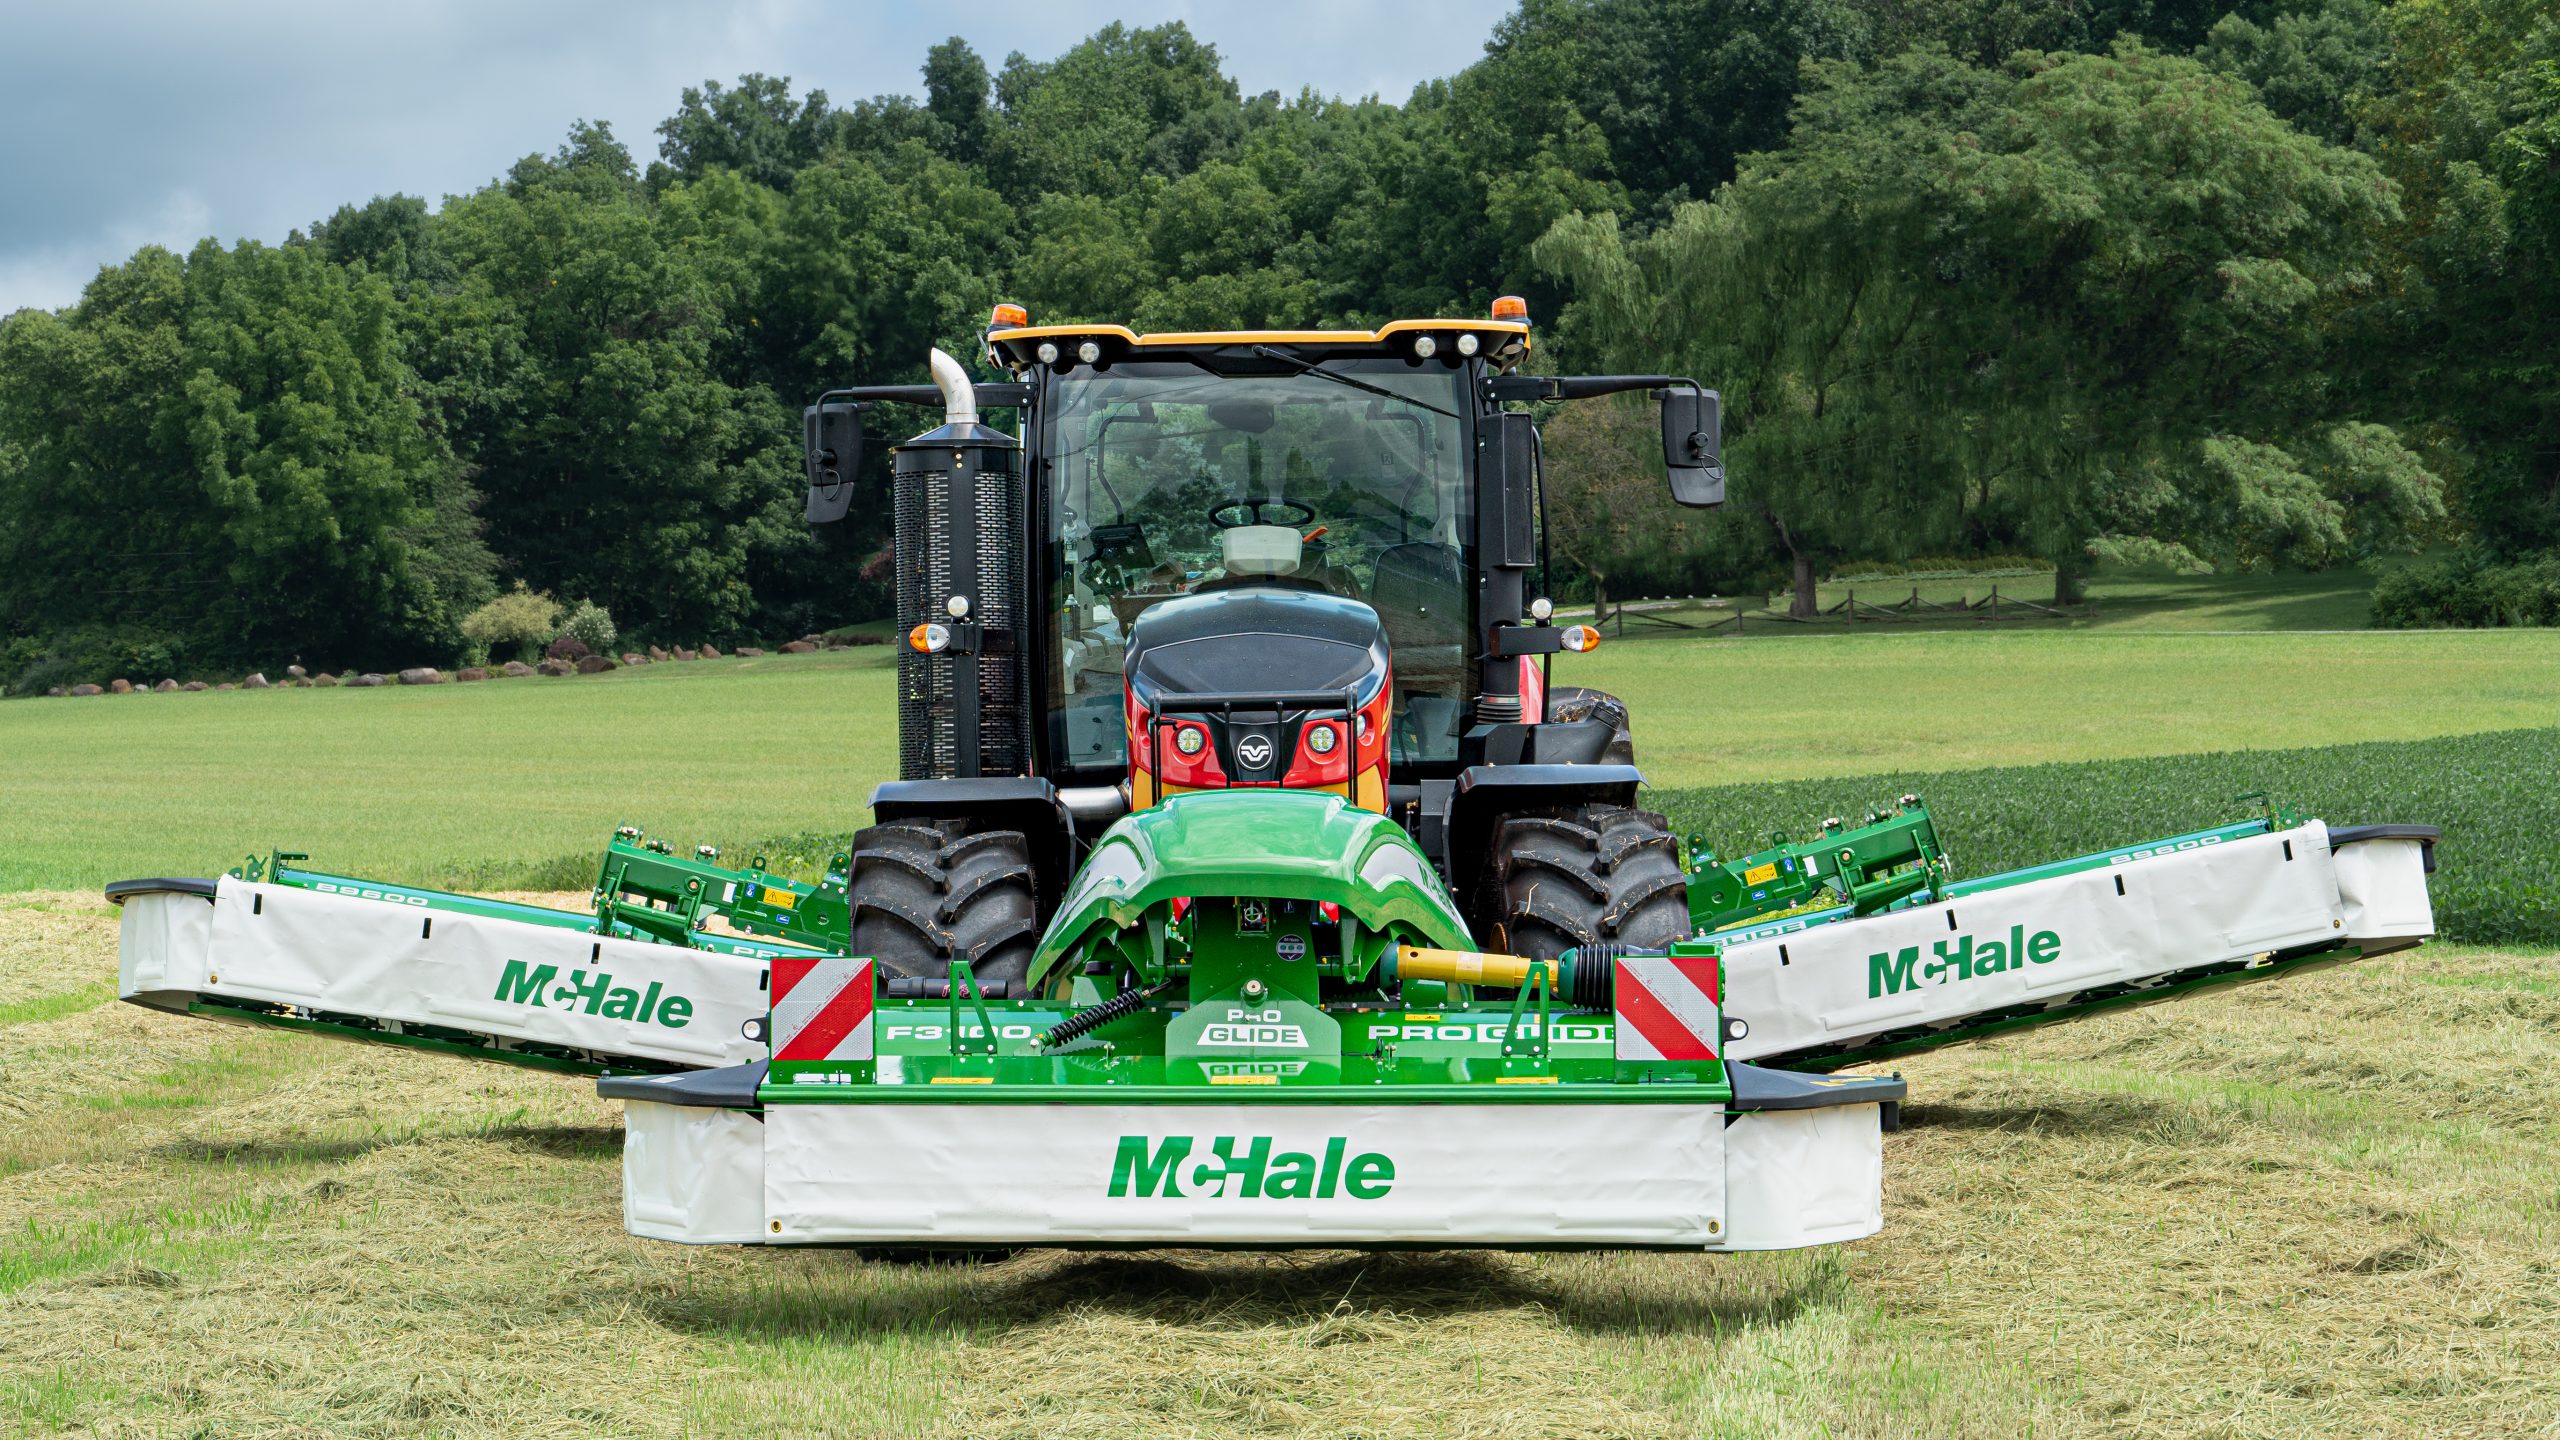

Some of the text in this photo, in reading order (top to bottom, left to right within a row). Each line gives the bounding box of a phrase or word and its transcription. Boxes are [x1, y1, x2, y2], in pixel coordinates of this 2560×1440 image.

[2110, 835, 2222, 865] B9600
[316, 882, 428, 906] B9600
[1714, 922, 1802, 946] LIDE
[1868, 924, 2061, 999] McHale
[494, 959, 694, 1028] McHale
[1208, 1027, 1299, 1043] GLIDE
[1107, 1136, 1396, 1200] McHale
